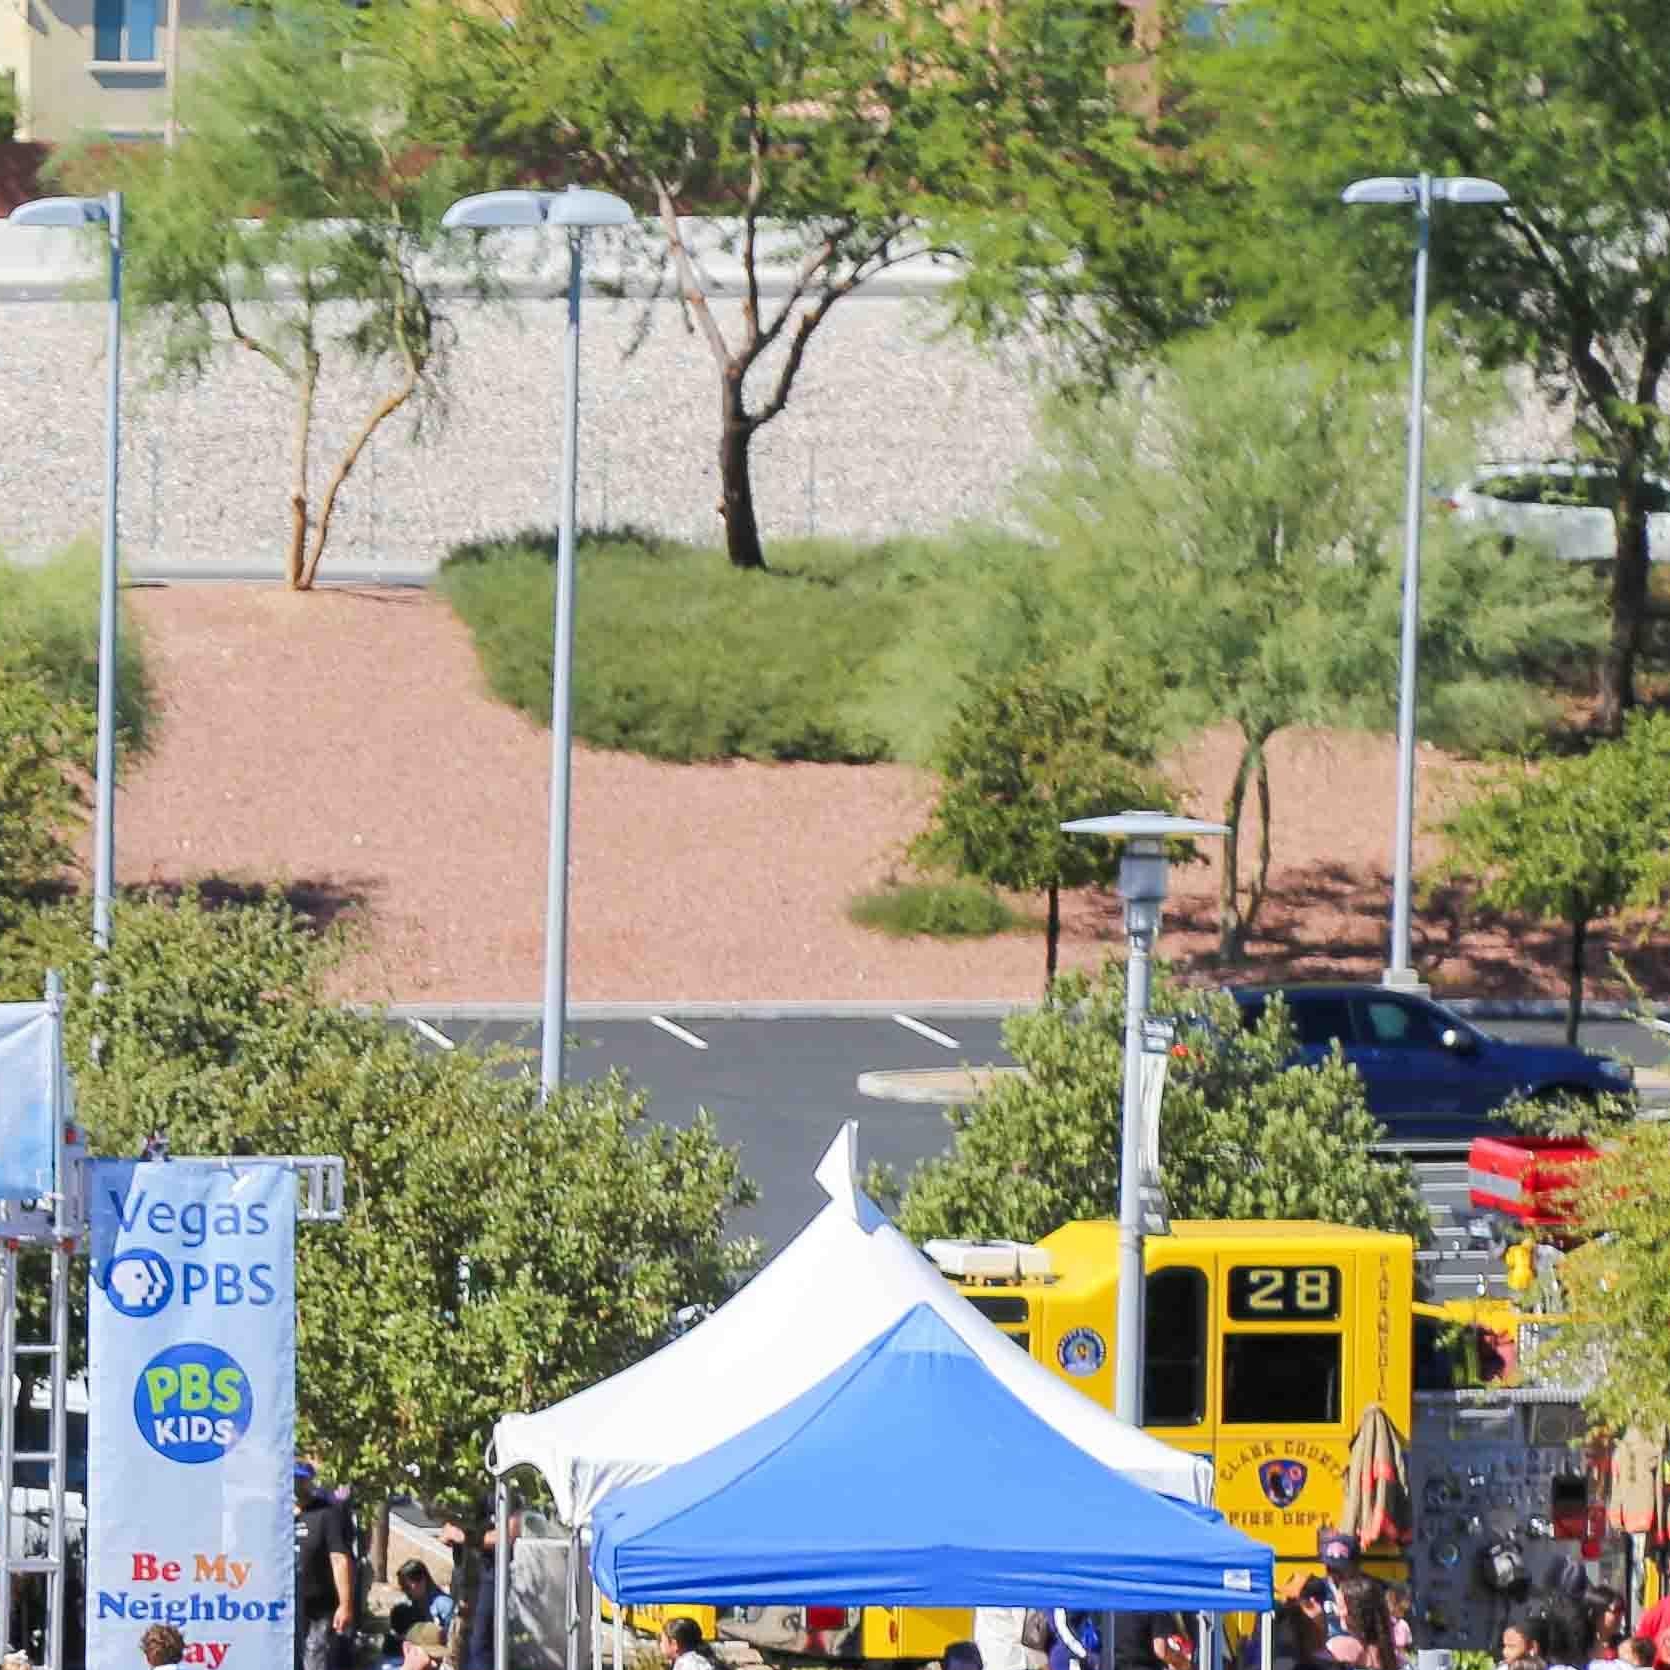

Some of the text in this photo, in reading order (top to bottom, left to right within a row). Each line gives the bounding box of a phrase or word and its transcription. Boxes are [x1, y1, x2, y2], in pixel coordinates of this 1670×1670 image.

[108, 1190, 270, 1248] Vegas
[183, 1263, 276, 1306] PBS
[1249, 1270, 1330, 1310] 28
[144, 1363, 243, 1414] PBS
[153, 1416, 236, 1446] KIDS
[1220, 1441, 1275, 1481] CLARK
[1229, 1511, 1274, 1526] FIRE
[131, 1552, 252, 1589] Be My
[96, 1591, 292, 1627] Neighbor
